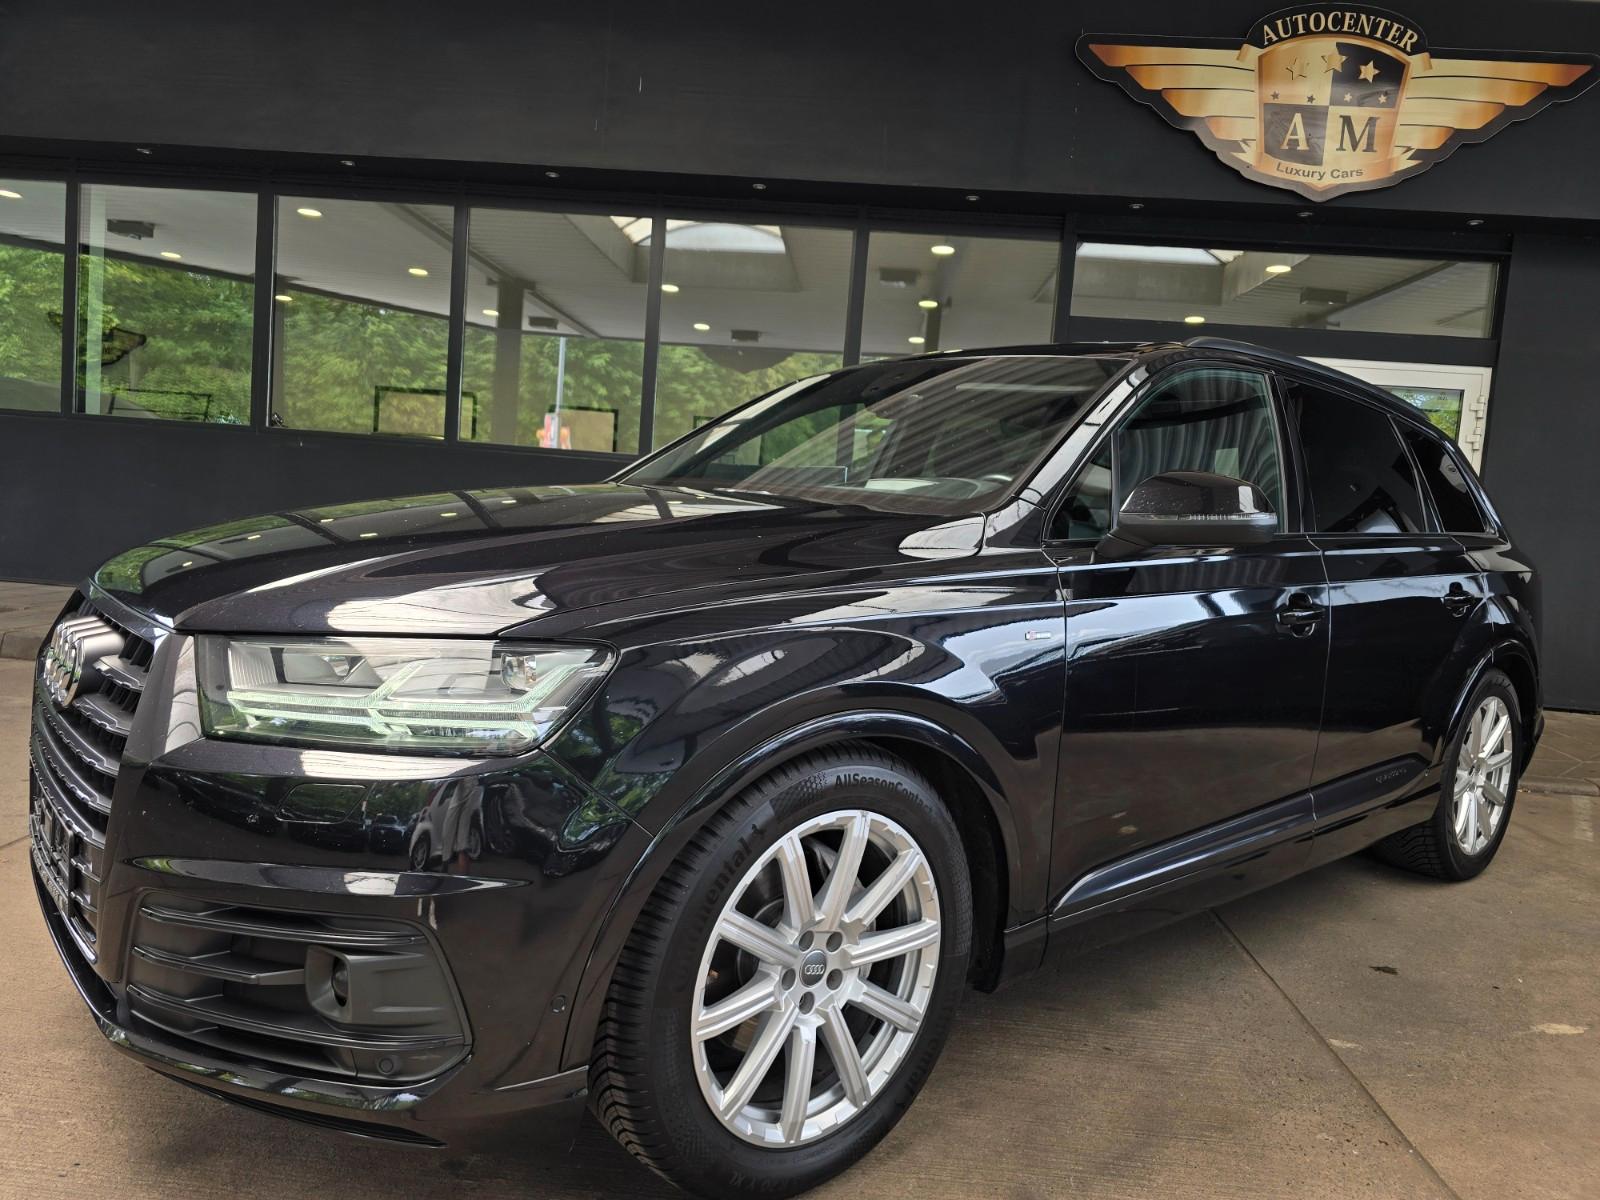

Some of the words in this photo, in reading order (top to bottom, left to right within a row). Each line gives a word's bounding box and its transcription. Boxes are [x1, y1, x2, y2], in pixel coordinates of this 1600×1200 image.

[1262, 11, 1419, 52] AUTOCENTER
[1280, 112, 1310, 151] A
[1335, 114, 1381, 153] M
[1276, 162, 1326, 181] Luxury
[1330, 168, 1364, 179] Cars
[834, 773, 934, 816] AllSeasonContac
